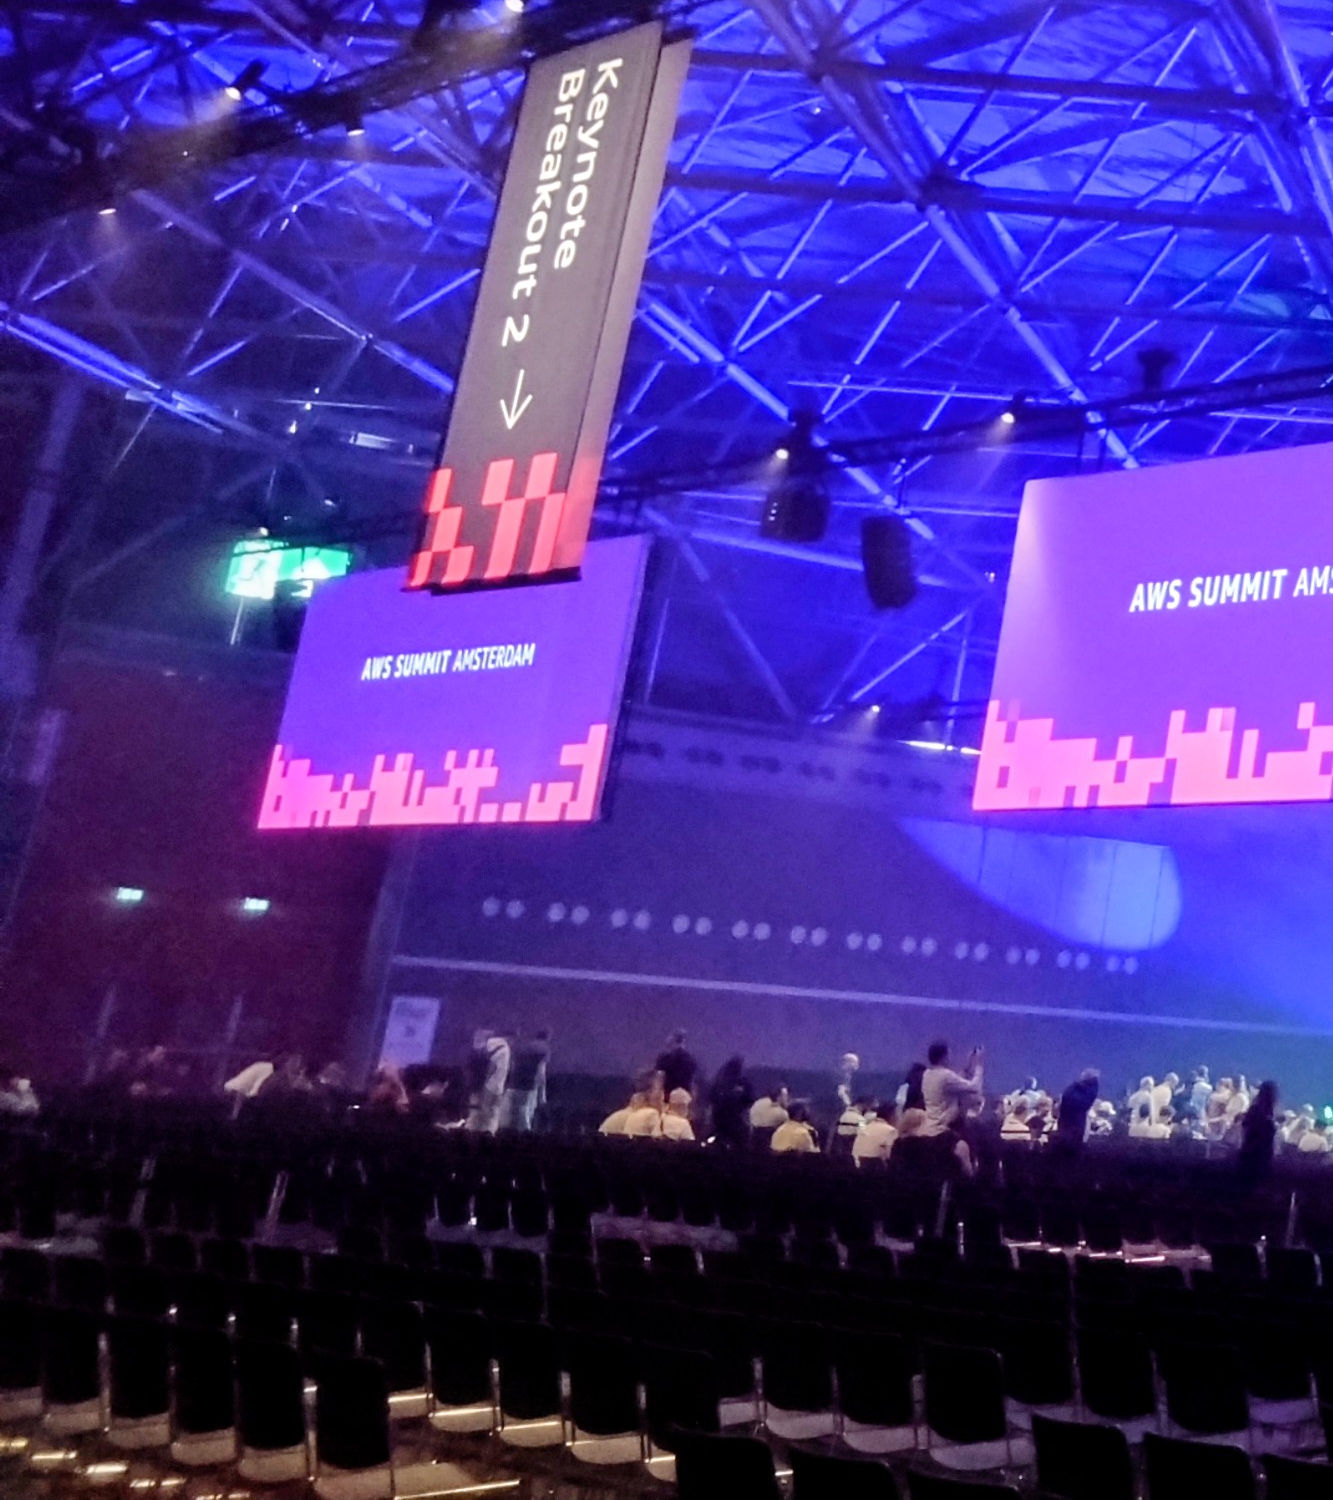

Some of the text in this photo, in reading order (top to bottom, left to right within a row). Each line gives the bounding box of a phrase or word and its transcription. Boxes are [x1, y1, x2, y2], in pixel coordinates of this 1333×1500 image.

[501, 68, 586, 347] Breakout 2
[553, 58, 623, 269] Keynote
[1129, 576, 1182, 613] AWS
[1187, 568, 1288, 608] SUMMIT
[360, 642, 536, 681] AWS SUMMIT AMSTERDAM
